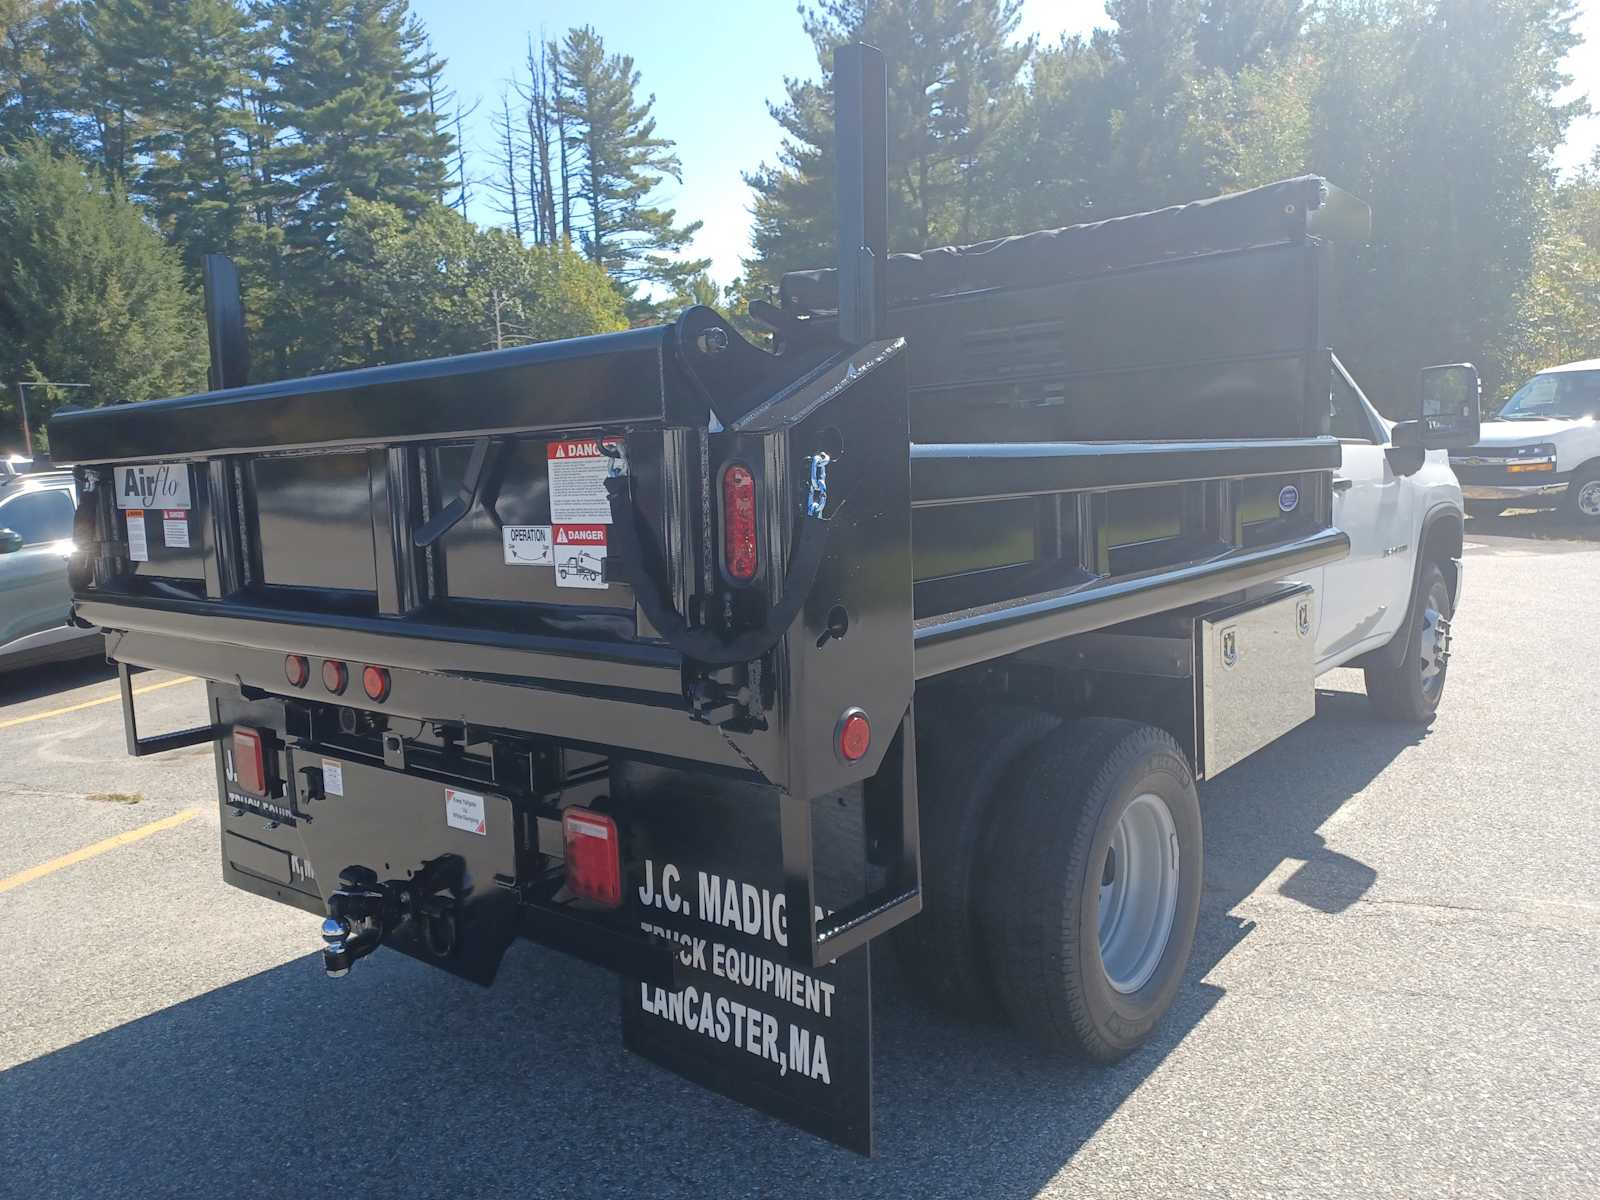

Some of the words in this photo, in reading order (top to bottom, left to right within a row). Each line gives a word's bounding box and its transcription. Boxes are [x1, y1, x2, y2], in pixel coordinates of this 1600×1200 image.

[567, 441, 617, 457] DANG
[124, 466, 178, 508] Airflo
[510, 528, 546, 542] OPERATION
[567, 529, 604, 540] DANGER
[638, 859, 691, 917] J.C.
[712, 942, 836, 1018] EQUIPMENT
